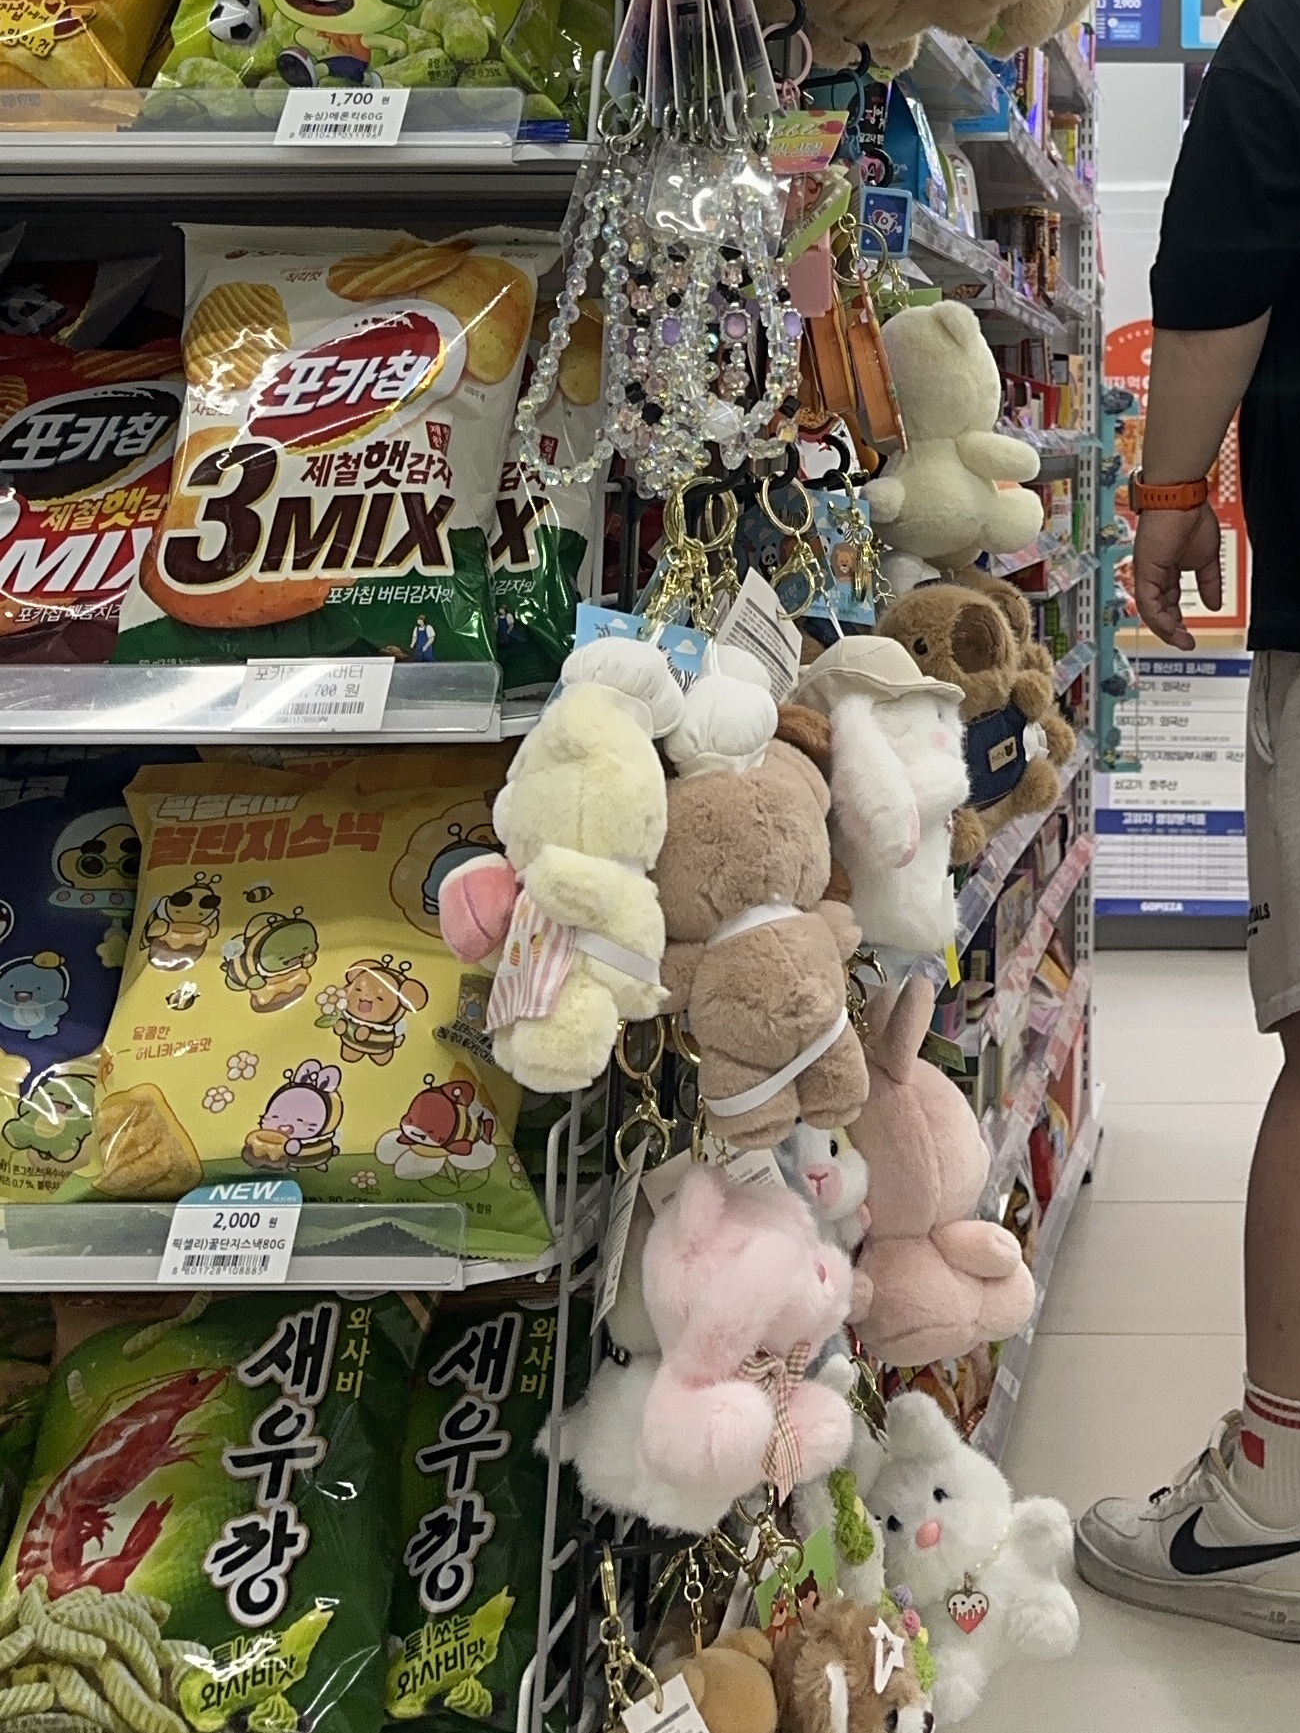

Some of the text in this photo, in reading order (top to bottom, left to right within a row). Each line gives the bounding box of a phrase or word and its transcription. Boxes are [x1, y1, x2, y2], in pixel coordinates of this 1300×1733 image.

[328, 91, 374, 108] 1,700
[252, 347, 431, 418] 포카칩
[0, 411, 169, 470] 포카칩
[300, 439, 454, 489] 제철햇감자
[39, 486, 169, 533] 제철햇감
[164, 440, 459, 593] 3MIX
[15, 604, 61, 623] 포카칩
[324, 584, 455, 606] 포카칩 버터감자맛
[299, 682, 361, 699] ,700 원
[147, 811, 385, 871] 꿀단지스낵
[132, 1025, 171, 1042] 달콤한
[208, 1180, 283, 1201] NEW
[171, 1236, 286, 1253] 픽셀리)꿀단지스낵80G
[211, 1211, 261, 1230] 2,000
[334, 1306, 373, 1400] 와사비
[517, 1317, 558, 1400] 와사비
[204, 1301, 341, 1627] 새우깡
[404, 1312, 523, 1613] 새우깡
[404, 1617, 471, 1663] 톡!쏘는
[200, 1653, 296, 1711] 와사비맛
[396, 1635, 487, 1700] 와사비맛
